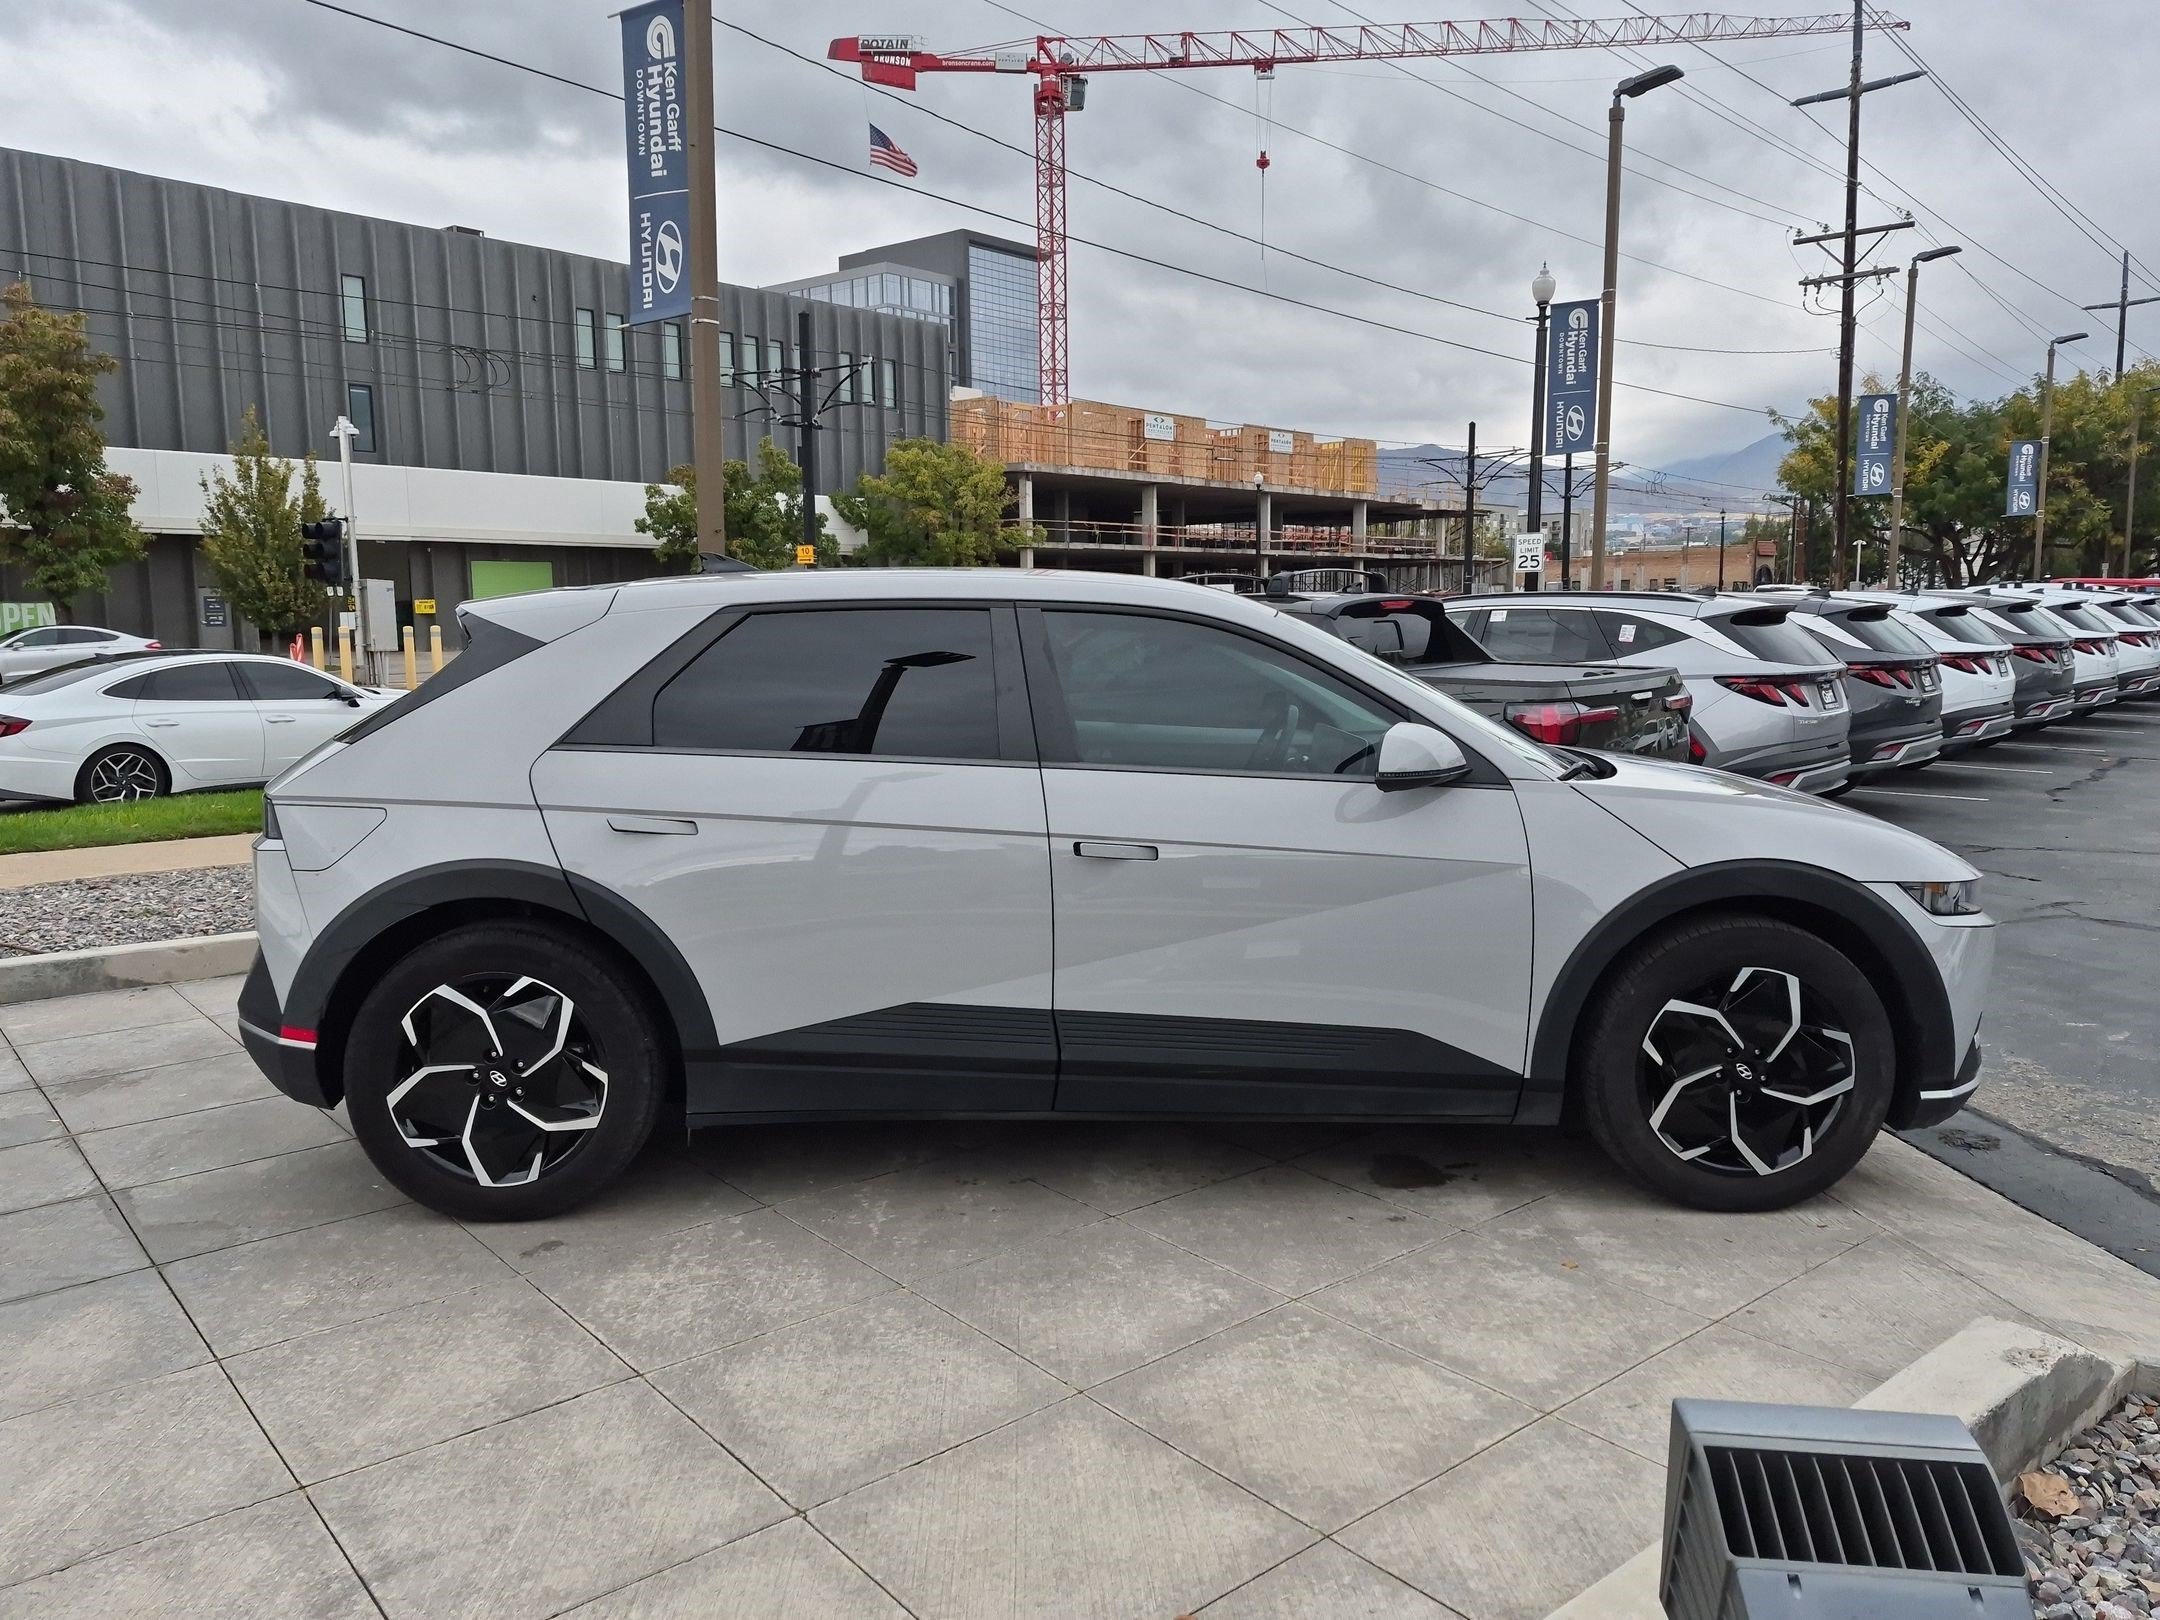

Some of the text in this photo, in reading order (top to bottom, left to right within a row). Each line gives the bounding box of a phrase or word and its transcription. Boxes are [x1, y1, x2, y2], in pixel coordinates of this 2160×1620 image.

[860, 39, 909, 49] POTAIN
[636, 69, 646, 156] DOWNTOWN
[646, 64, 668, 178] Hyundai
[664, 61, 682, 152] Ken Garff
[640, 212, 653, 309] HYUNDAI
[1578, 330, 1588, 349] Ken
[1565, 331, 1578, 385] Hyundai
[1556, 401, 1564, 449] HYUNDAI
[1870, 413, 1881, 450] Hyundai
[1862, 459, 1870, 491] HYUNDAI
[801, 547, 810, 555] 10
[1518, 538, 1542, 546] SPEED
[1518, 554, 1540, 569] 25
[0, 602, 57, 633] PEN
